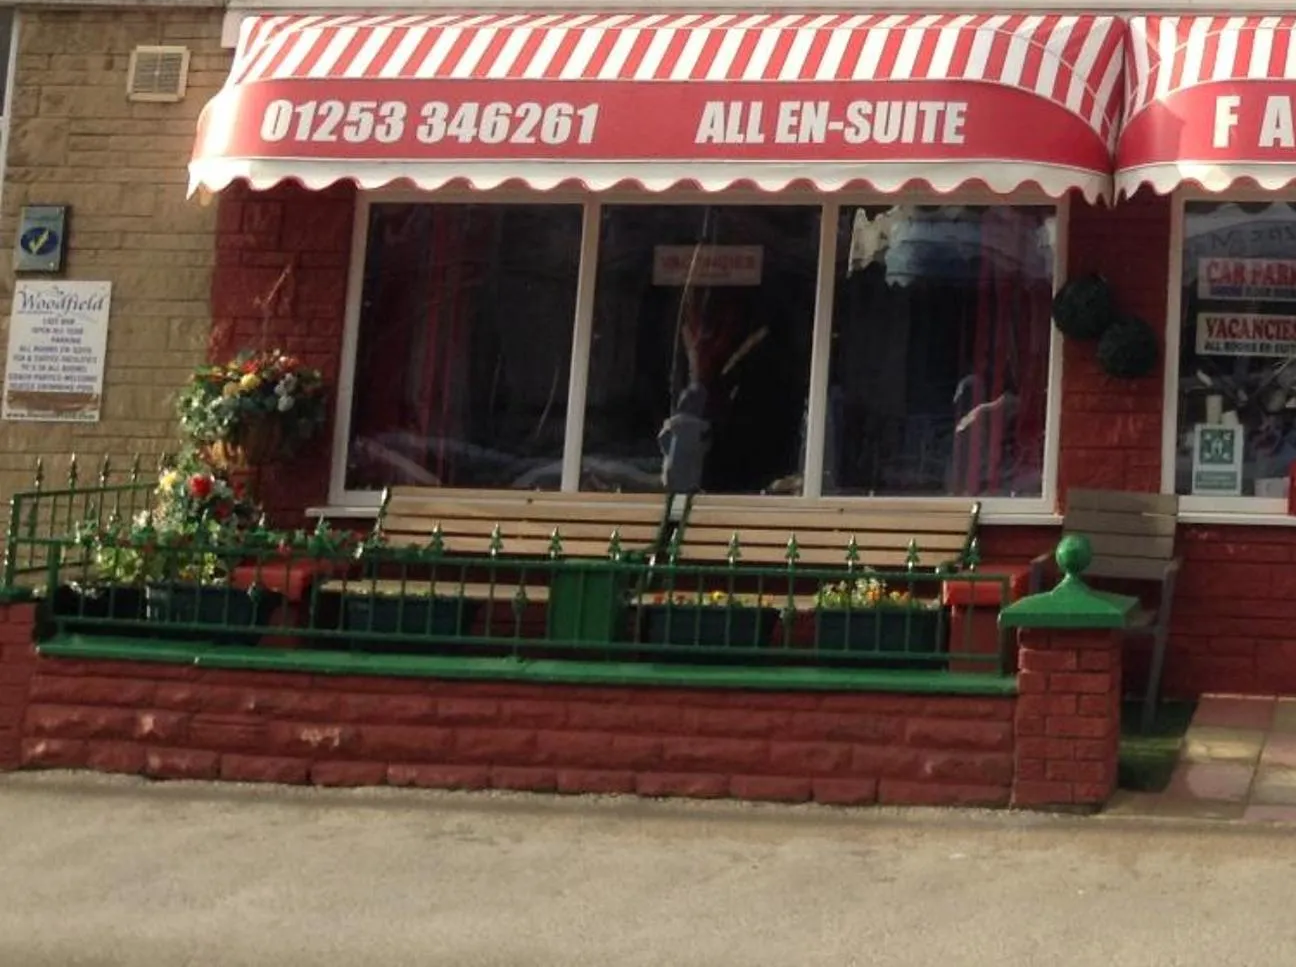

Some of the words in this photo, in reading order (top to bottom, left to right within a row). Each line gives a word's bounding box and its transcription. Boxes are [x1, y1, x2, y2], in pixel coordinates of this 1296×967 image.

[261, 99, 406, 144] 01253
[416, 100, 601, 145] 346261
[695, 100, 765, 144] ALL
[775, 100, 968, 145] EN-SUITE
[17, 289, 106, 314] Woodfield
